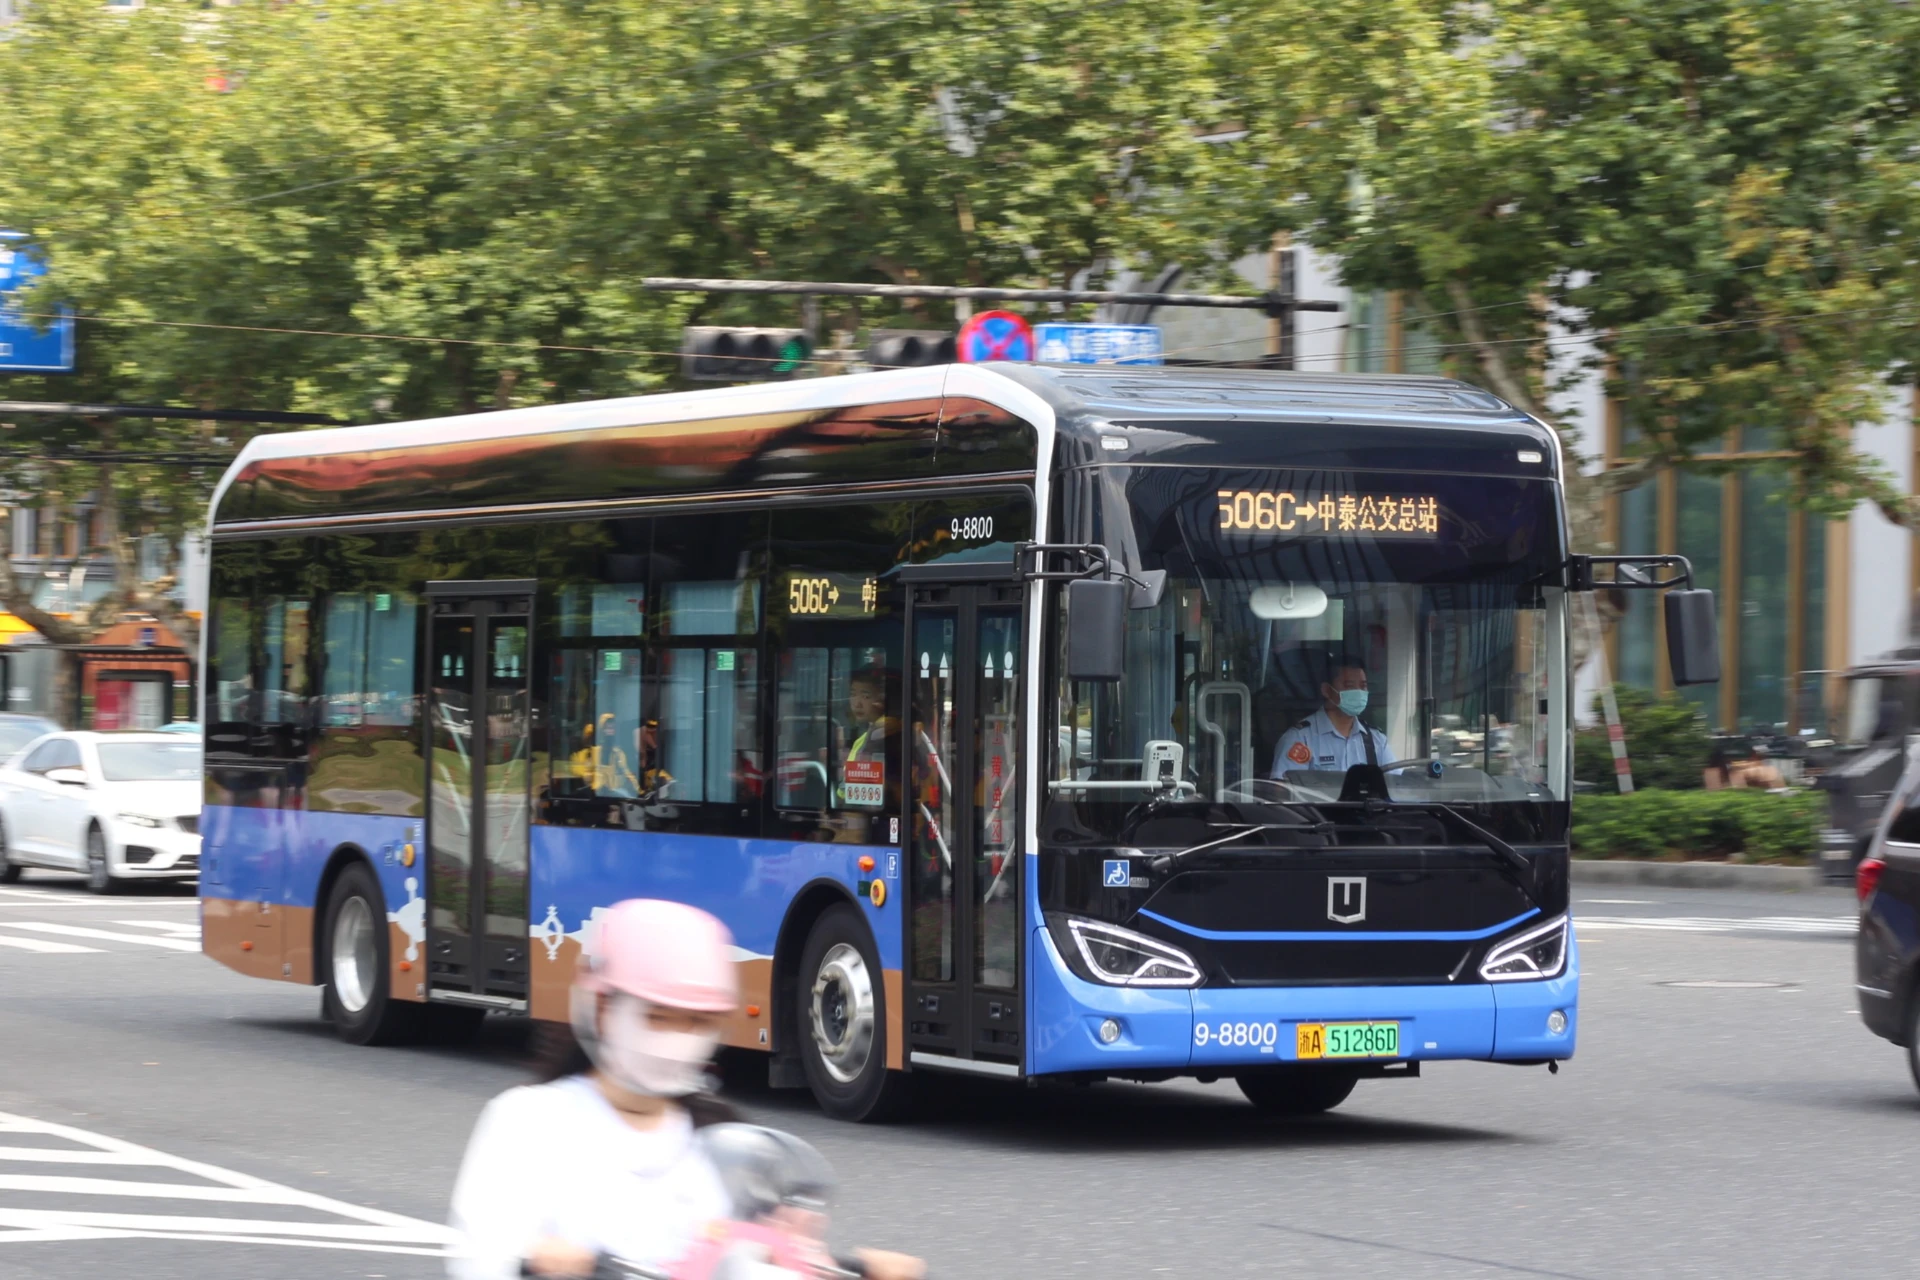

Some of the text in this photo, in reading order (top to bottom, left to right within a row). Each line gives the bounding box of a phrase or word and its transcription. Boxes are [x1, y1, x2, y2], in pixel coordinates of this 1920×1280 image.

[1218, 491, 1437, 532] 506C 中泰公交总站
[951, 516, 993, 540] 9-8800
[790, 578, 829, 613] 506C
[1195, 1022, 1277, 1046] 9-8800
